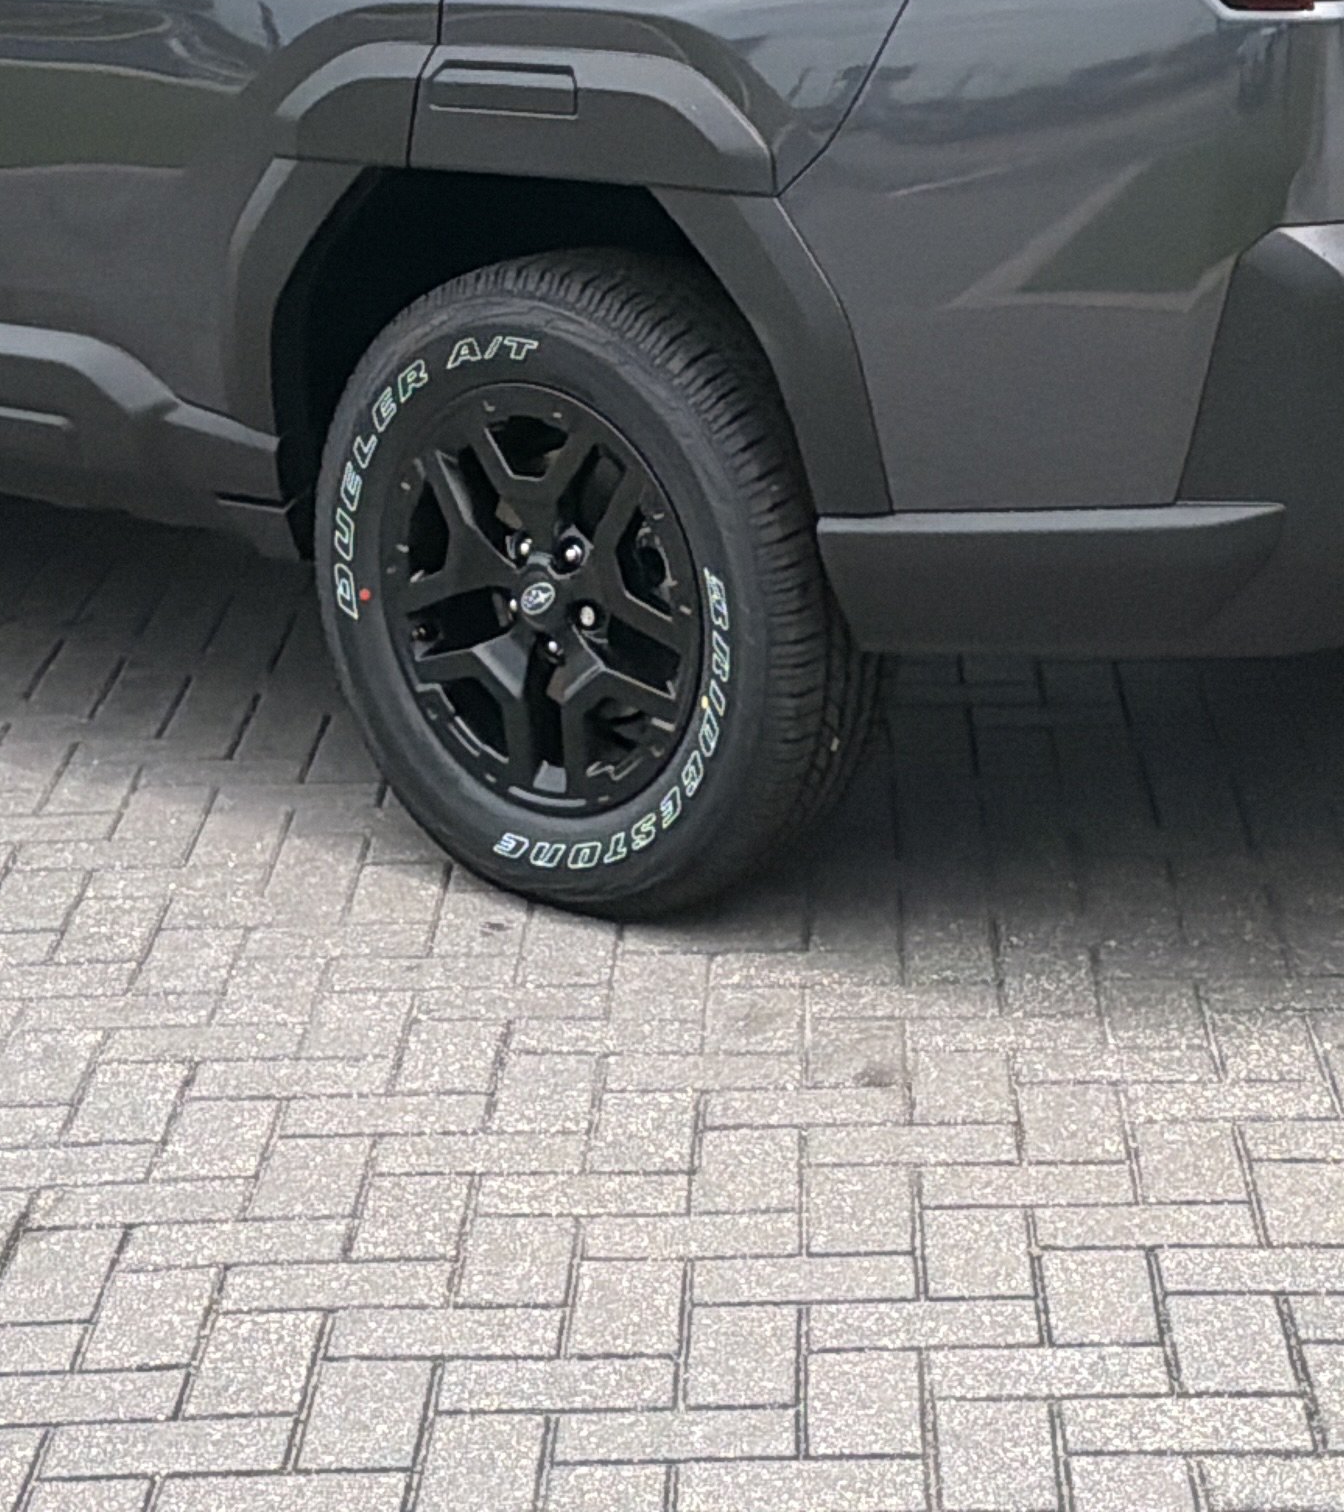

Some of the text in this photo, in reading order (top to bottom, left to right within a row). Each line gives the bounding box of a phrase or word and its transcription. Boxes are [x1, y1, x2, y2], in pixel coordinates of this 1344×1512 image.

[335, 335, 539, 621] DUELER A/T
[494, 567, 730, 868] BRIDGESTONE
